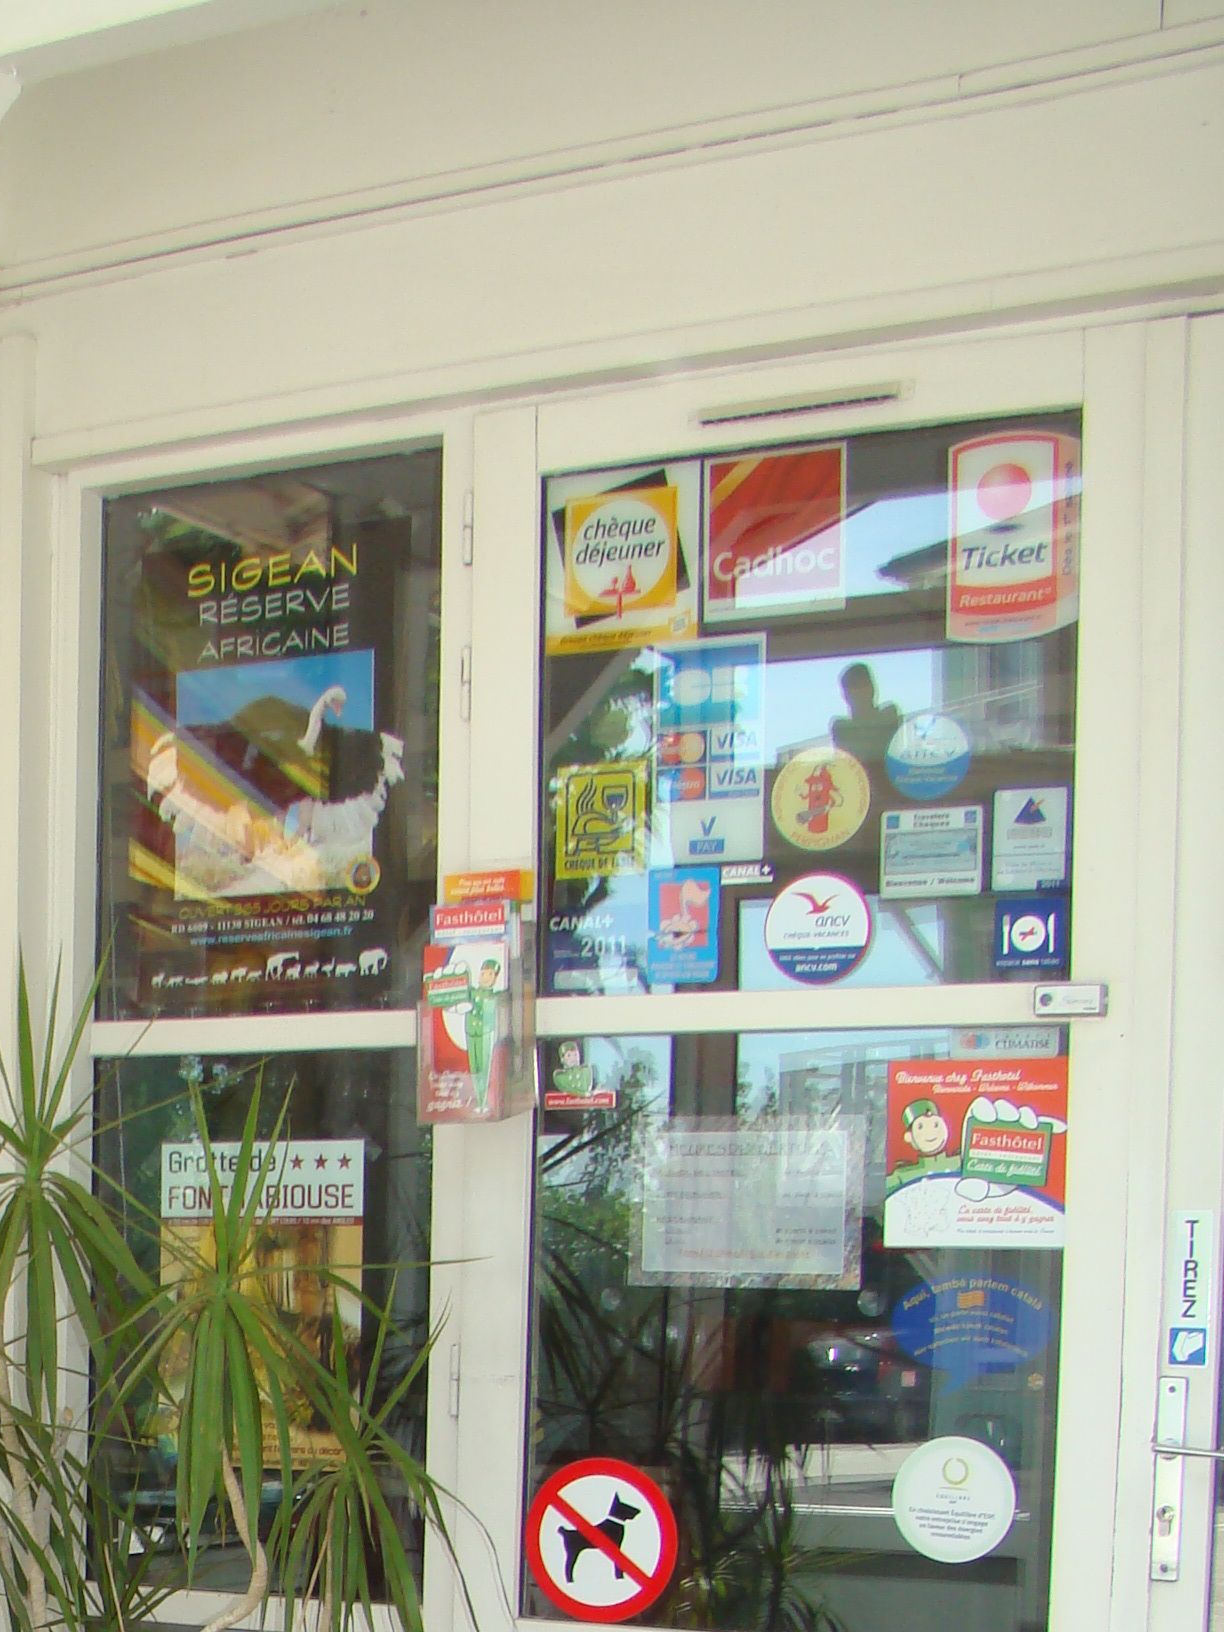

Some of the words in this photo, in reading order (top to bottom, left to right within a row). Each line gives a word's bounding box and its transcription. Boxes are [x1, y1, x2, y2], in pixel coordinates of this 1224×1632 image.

[583, 516, 656, 541] chèque
[576, 540, 665, 567] déjeuner
[713, 545, 835, 581] Cadhoc
[962, 542, 1049, 571] Ticket
[188, 543, 358, 597] SIGEAN
[199, 582, 350, 626] RÉSERVE
[717, 731, 757, 750] VISA
[717, 767, 757, 785] VISA
[700, 816, 717, 837] V
[243, 916, 283, 930] SIGEAN
[307, 911, 319, 924] 04
[348, 908, 361, 922] 20
[436, 907, 502, 927] Fasthôtel
[550, 914, 614, 932] CANAL+
[815, 915, 851, 927] ancv
[580, 935, 626, 957] 2011
[795, 963, 838, 973] ancv.com
[895, 1071, 944, 1084] Bienvenue
[945, 1072, 968, 1084] chez
[971, 1133, 1042, 1150] Fasthôtel
[1181, 1219, 1200, 1318] TIREZ
[968, 1278, 1010, 1293] parlem
